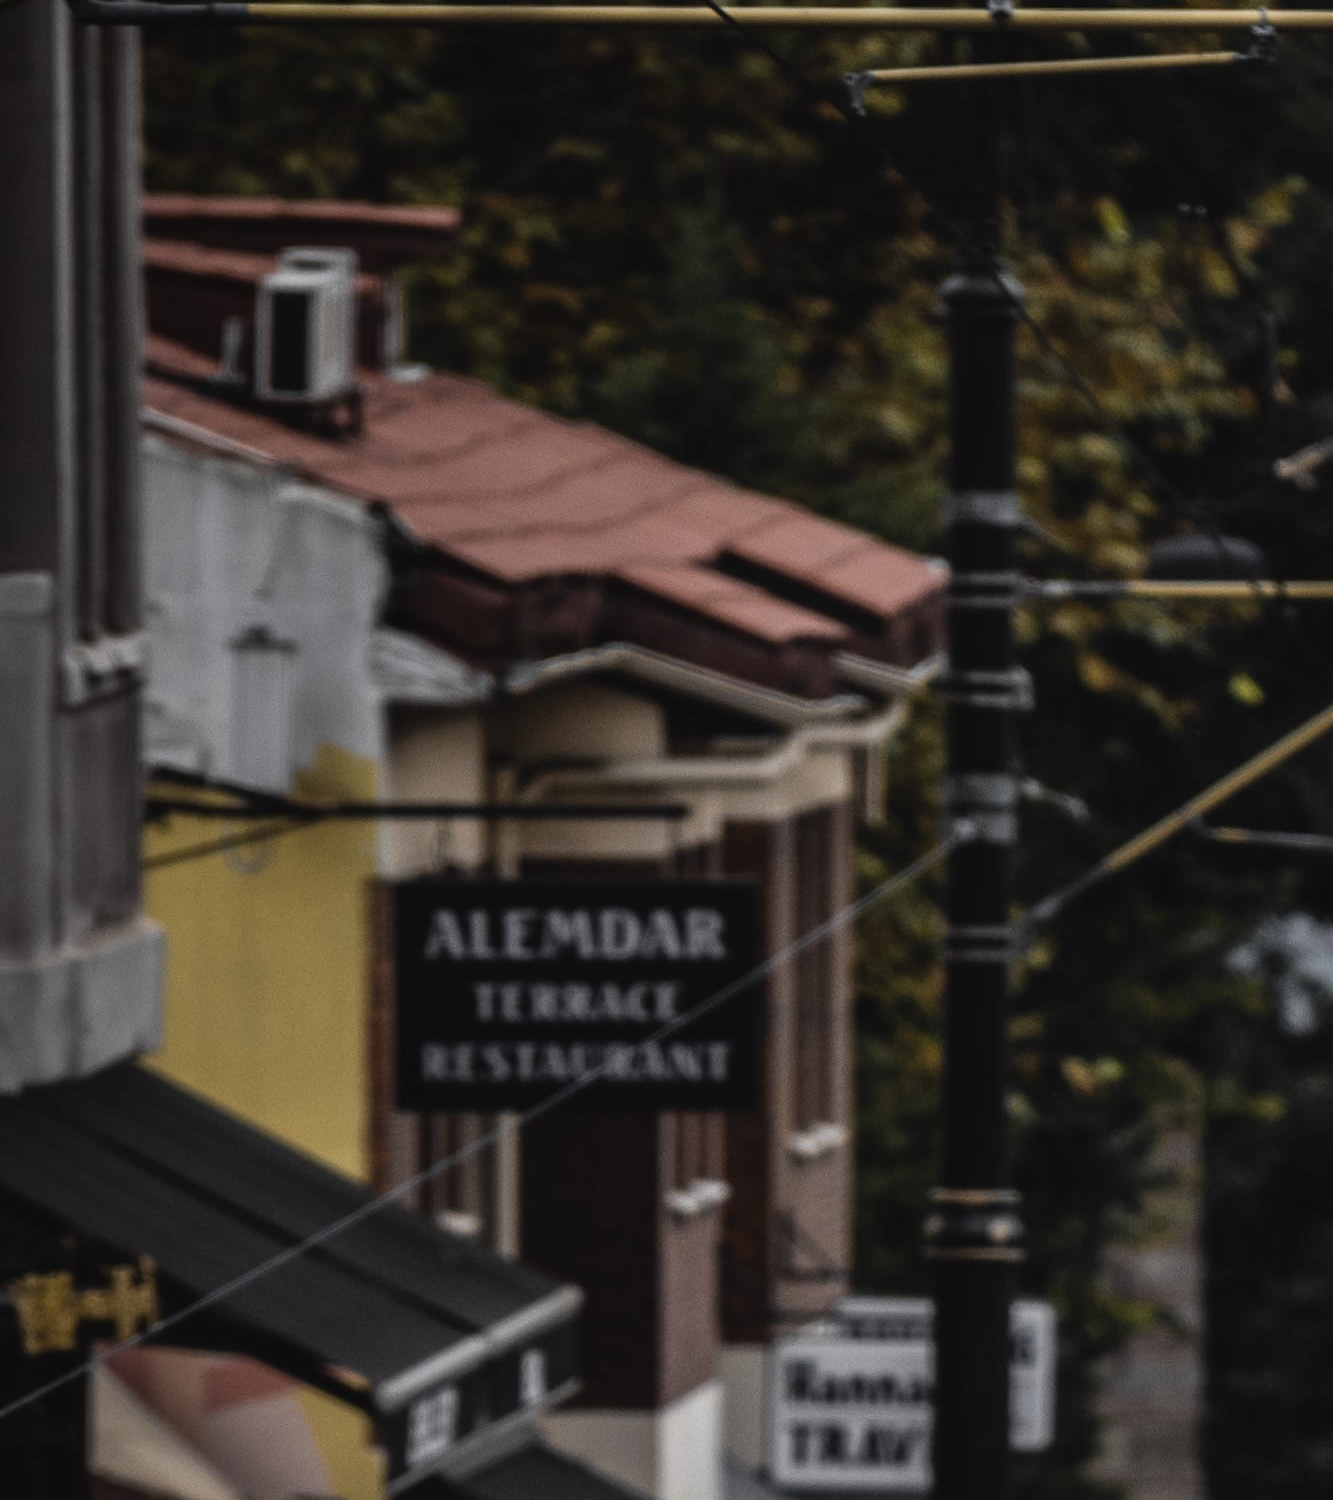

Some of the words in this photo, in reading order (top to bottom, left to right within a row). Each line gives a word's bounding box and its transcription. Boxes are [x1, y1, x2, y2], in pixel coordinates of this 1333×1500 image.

[424, 906, 728, 961] ALEMDAR
[472, 980, 682, 1023] TERRACE
[421, 1040, 731, 1082] RESTAURANT
